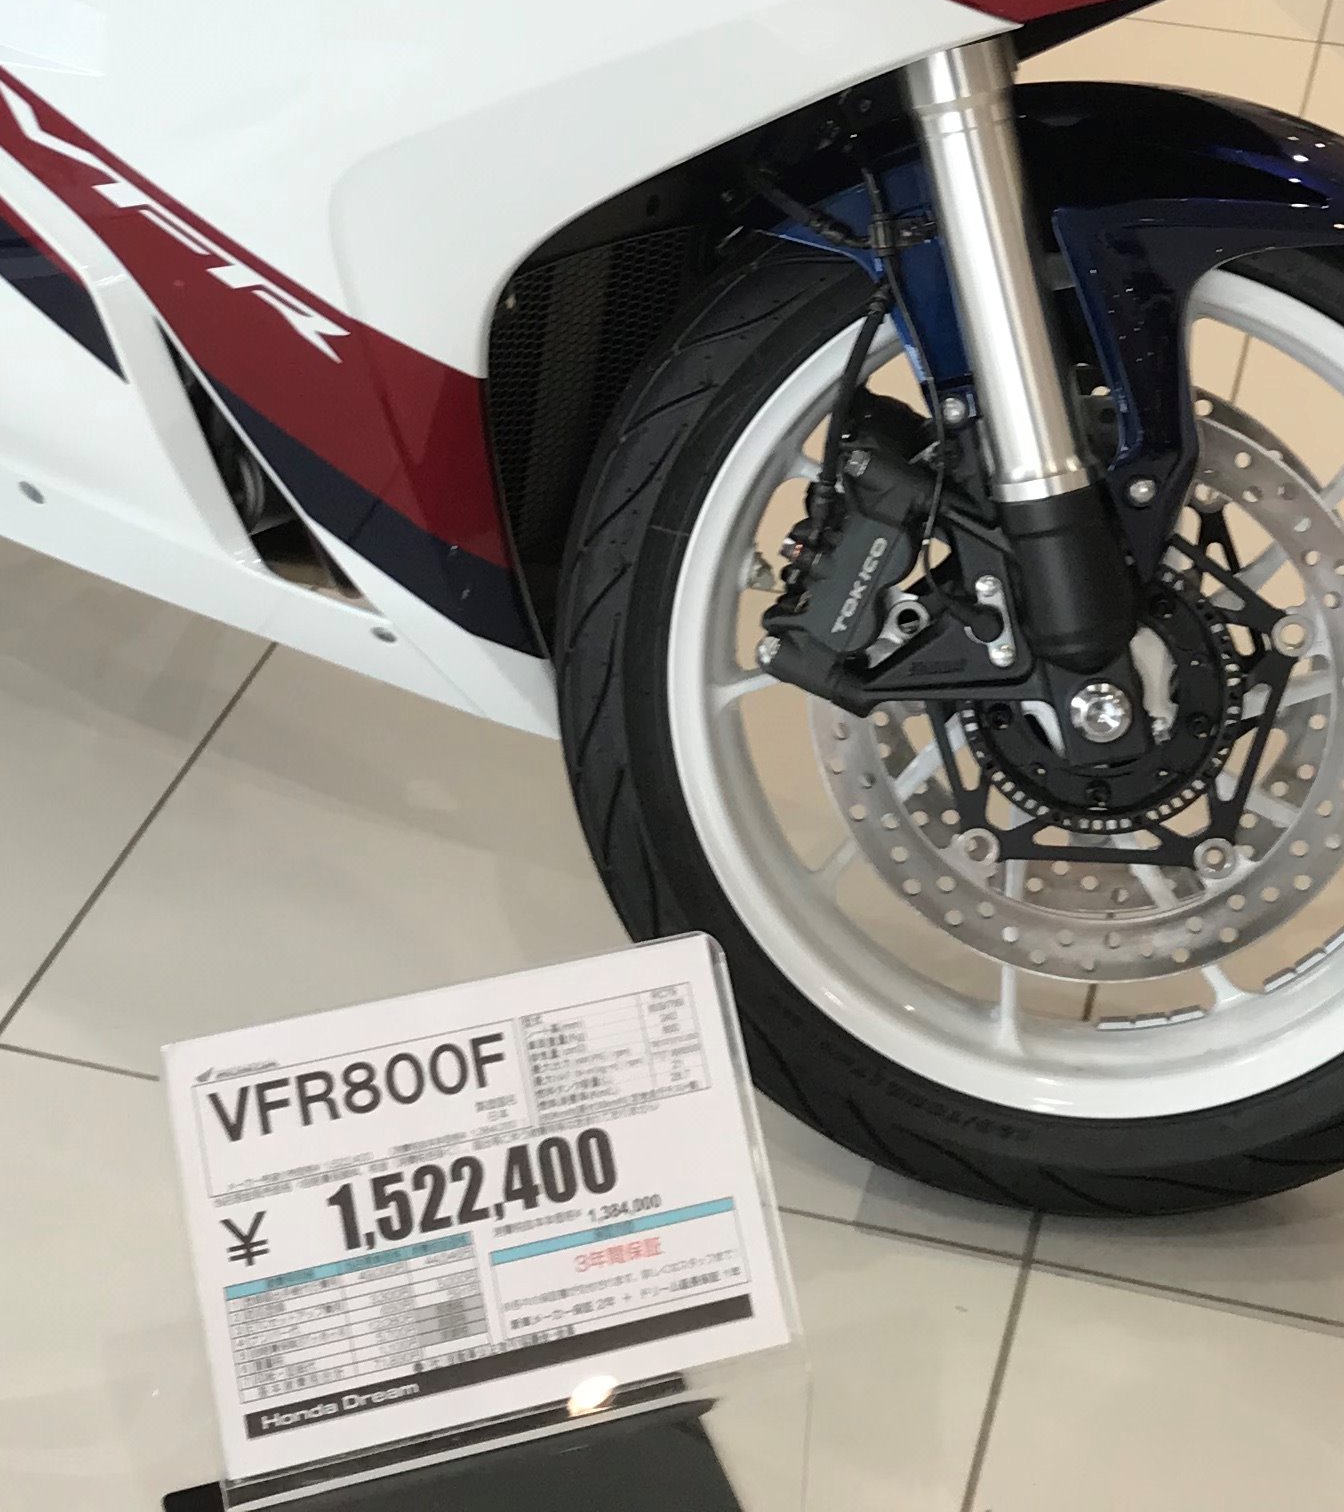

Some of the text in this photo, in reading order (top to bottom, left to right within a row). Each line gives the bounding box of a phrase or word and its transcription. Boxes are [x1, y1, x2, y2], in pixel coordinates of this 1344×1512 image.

[831, 538, 888, 633] TOKICO
[207, 1032, 504, 1142] VFR800F
[220, 1211, 269, 1266] ¥
[327, 1128, 617, 1250] 1,522,400
[587, 1194, 662, 1222] 1,384,000
[574, 1237, 664, 1273] 3年間保証
[260, 1383, 420, 1430] Honda Dream
